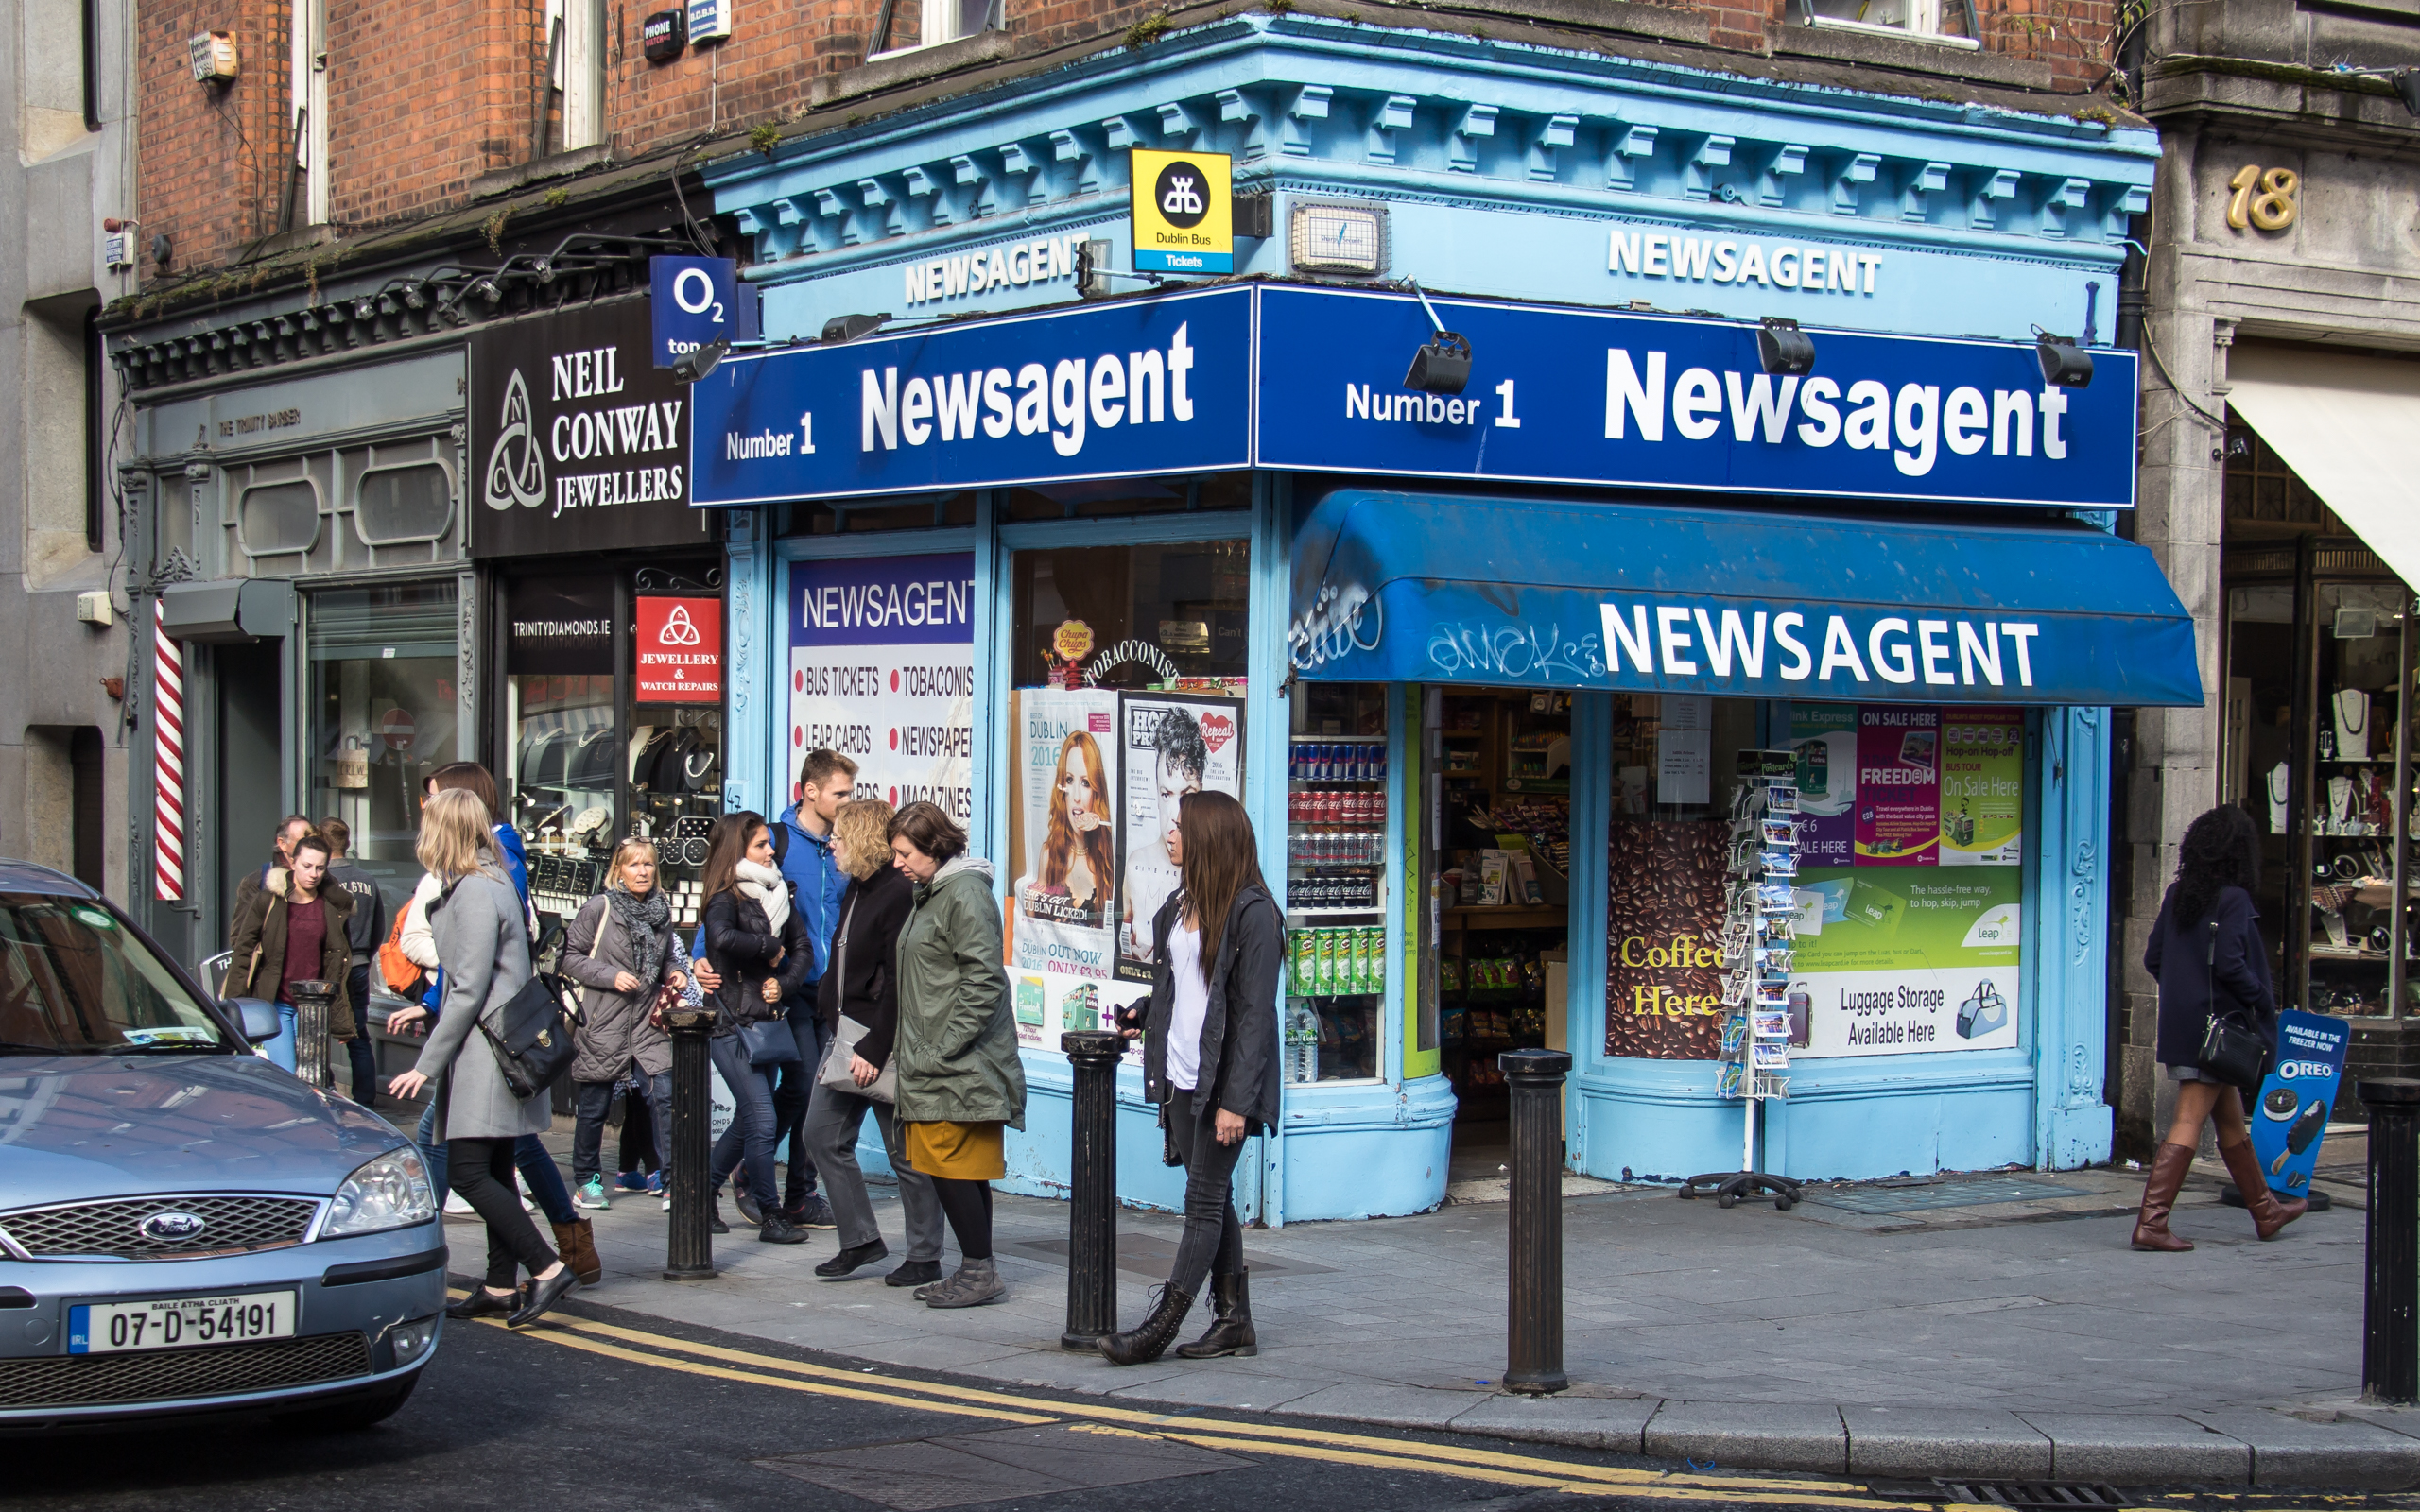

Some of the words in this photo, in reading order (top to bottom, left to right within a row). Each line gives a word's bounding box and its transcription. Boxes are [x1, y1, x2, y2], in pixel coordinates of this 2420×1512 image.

[645, 20, 670, 39] PHONE
[646, 35, 664, 47] WATCH
[2228, 164, 2298, 230] 18
[1156, 232, 1188, 244] Dublin
[1192, 234, 1211, 245] Bus
[906, 233, 1090, 304] NEWSAGENT
[1166, 254, 1202, 267] Tickets
[1608, 231, 1883, 295] NEWSAGENT
[674, 268, 724, 322] O2
[552, 347, 624, 401] NEIL
[862, 320, 1194, 456] Newsagent
[1346, 383, 1480, 426] Number
[1494, 380, 1521, 429] 1
[1604, 348, 2068, 476] Newsagent
[219, 421, 233, 437] THE
[237, 414, 265, 436] TRINITY
[268, 408, 301, 429] BARBER
[552, 401, 682, 462] CONWAY
[726, 428, 794, 461] Number
[800, 412, 816, 455] 1
[553, 465, 683, 518] JEWELLERS
[514, 620, 611, 636] TRINITYDIAMONDS.IE
[1061, 629, 1088, 641] Chupa
[1219, 627, 1241, 637] Can't
[1059, 639, 1086, 653] Chups
[1599, 603, 2039, 687] NEWSAGENT
[641, 654, 718, 665] JEWELLERY
[1084, 640, 1181, 688] TOBACCONIST
[674, 669, 685, 679] &
[806, 667, 829, 696] BUS
[833, 666, 879, 696] TICKETS
[641, 682, 675, 691] WATCH
[678, 683, 718, 692] REPAIRS
[1811, 711, 1853, 724] Express
[1862, 713, 1881, 726] ON
[1883, 713, 1908, 726] SALE
[1910, 713, 1936, 726] HERE
[1030, 718, 1068, 739] DUBLIN
[1201, 722, 1233, 741] Repeal
[805, 724, 832, 753] LEAP
[836, 725, 871, 754] CARDS
[1031, 746, 1061, 766] 2016
[1862, 754, 1869, 766] 3
[1873, 755, 1893, 766] DAY
[1946, 747, 1979, 758] Hop-on
[1981, 746, 2014, 758] Hop-off
[1761, 760, 1794, 776] Postcards
[1962, 763, 1981, 771] TOUR
[1861, 768, 1936, 785] FREEDOM
[1862, 787, 1916, 802] TICKET
[1944, 777, 1961, 796] On
[1964, 776, 1988, 797] Sale
[1991, 776, 2019, 797] Here
[1802, 819, 1807, 832] €
[1810, 819, 1817, 832] 6
[1821, 841, 1847, 853] HERE
[351, 881, 372, 896] GYM
[1024, 889, 1049, 902] SHE'S
[1049, 896, 1070, 905] GOT
[1910, 885, 1926, 894] The
[1927, 885, 1972, 894] hassle-free
[1974, 885, 1991, 896] way,
[1024, 900, 1052, 915] DUBLIN
[1053, 905, 1087, 920] LICKED!
[1865, 904, 1883, 919] leap
[1910, 900, 1919, 908] to
[1922, 899, 1939, 909] hop,
[1941, 898, 1959, 909] skip,
[1960, 899, 1980, 909] jump
[1979, 928, 1999, 939] leap
[1022, 943, 1046, 956] DUBLIN
[1048, 943, 1071, 960] OUT
[1074, 948, 1102, 965] NOW
[1621, 936, 1725, 968] Coffee
[1022, 957, 1042, 971] 2016
[1048, 960, 1077, 975] ONLY
[1120, 965, 1141, 977] ONLY
[1633, 986, 1718, 1016] Here
[1841, 988, 1893, 1016] Luggage
[1897, 985, 1944, 1012] Storage
[1848, 1021, 1904, 1046] Available
[1908, 1020, 1935, 1043] Here
[2285, 1024, 2319, 1040] AVAILABLE
[2329, 1034, 2341, 1043] THE
[2289, 1036, 2316, 1050] FREEZER
[2316, 1042, 2333, 1053] NOW
[2279, 1062, 2332, 1079] OREO
[159, 1218, 191, 1233] Ford
[111, 1302, 275, 1347] 07-D-54191
[71, 1335, 88, 1346] IRL
